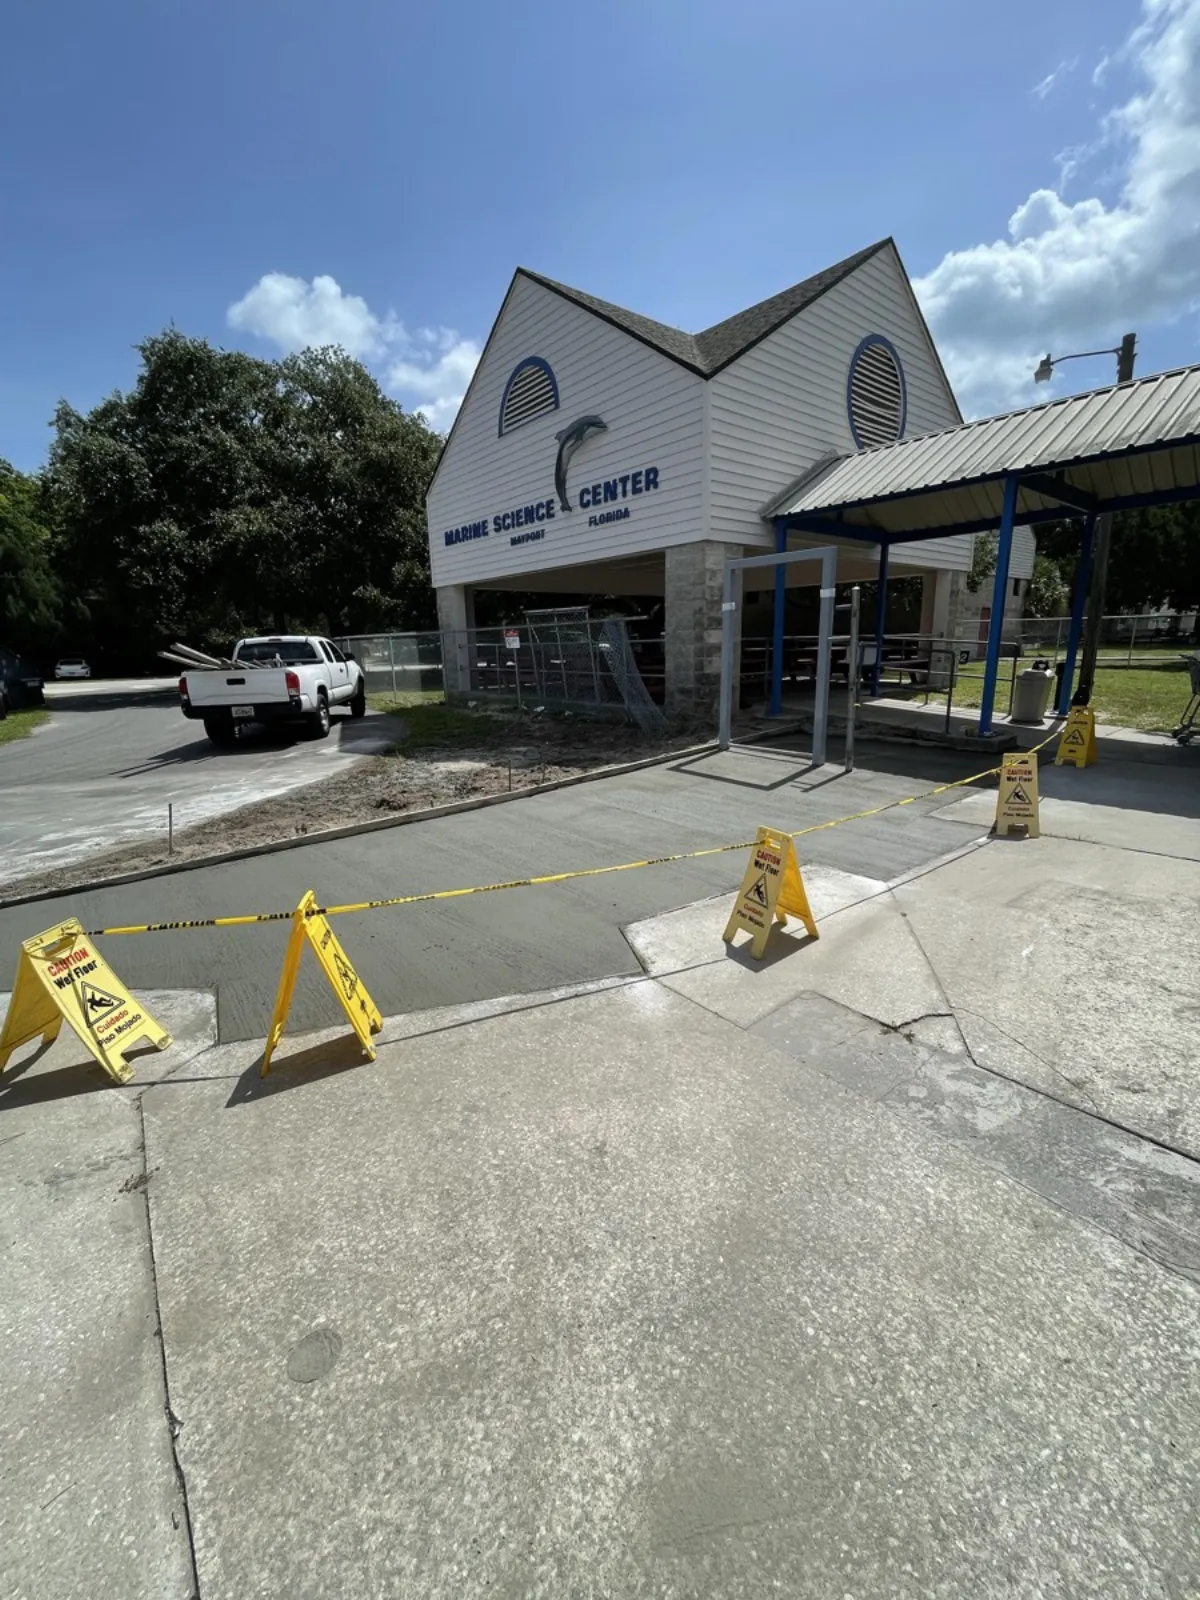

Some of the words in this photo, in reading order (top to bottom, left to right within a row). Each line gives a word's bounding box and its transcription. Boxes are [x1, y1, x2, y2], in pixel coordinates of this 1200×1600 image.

[444, 519, 489, 547] MARINE
[493, 499, 556, 533] SCIENCE
[579, 466, 660, 509] CENTER
[510, 528, 546, 546] MAYPORT
[588, 507, 630, 527] FLORIDA
[756, 849, 781, 866] CAUTION
[47, 947, 90, 977] CAUTION
[53, 972, 76, 990] Wet
[73, 959, 98, 980] Floor
[96, 1009, 129, 1034] Cuidado
[97, 1033, 116, 1047] Piso
[116, 1013, 142, 1036] Mojado
